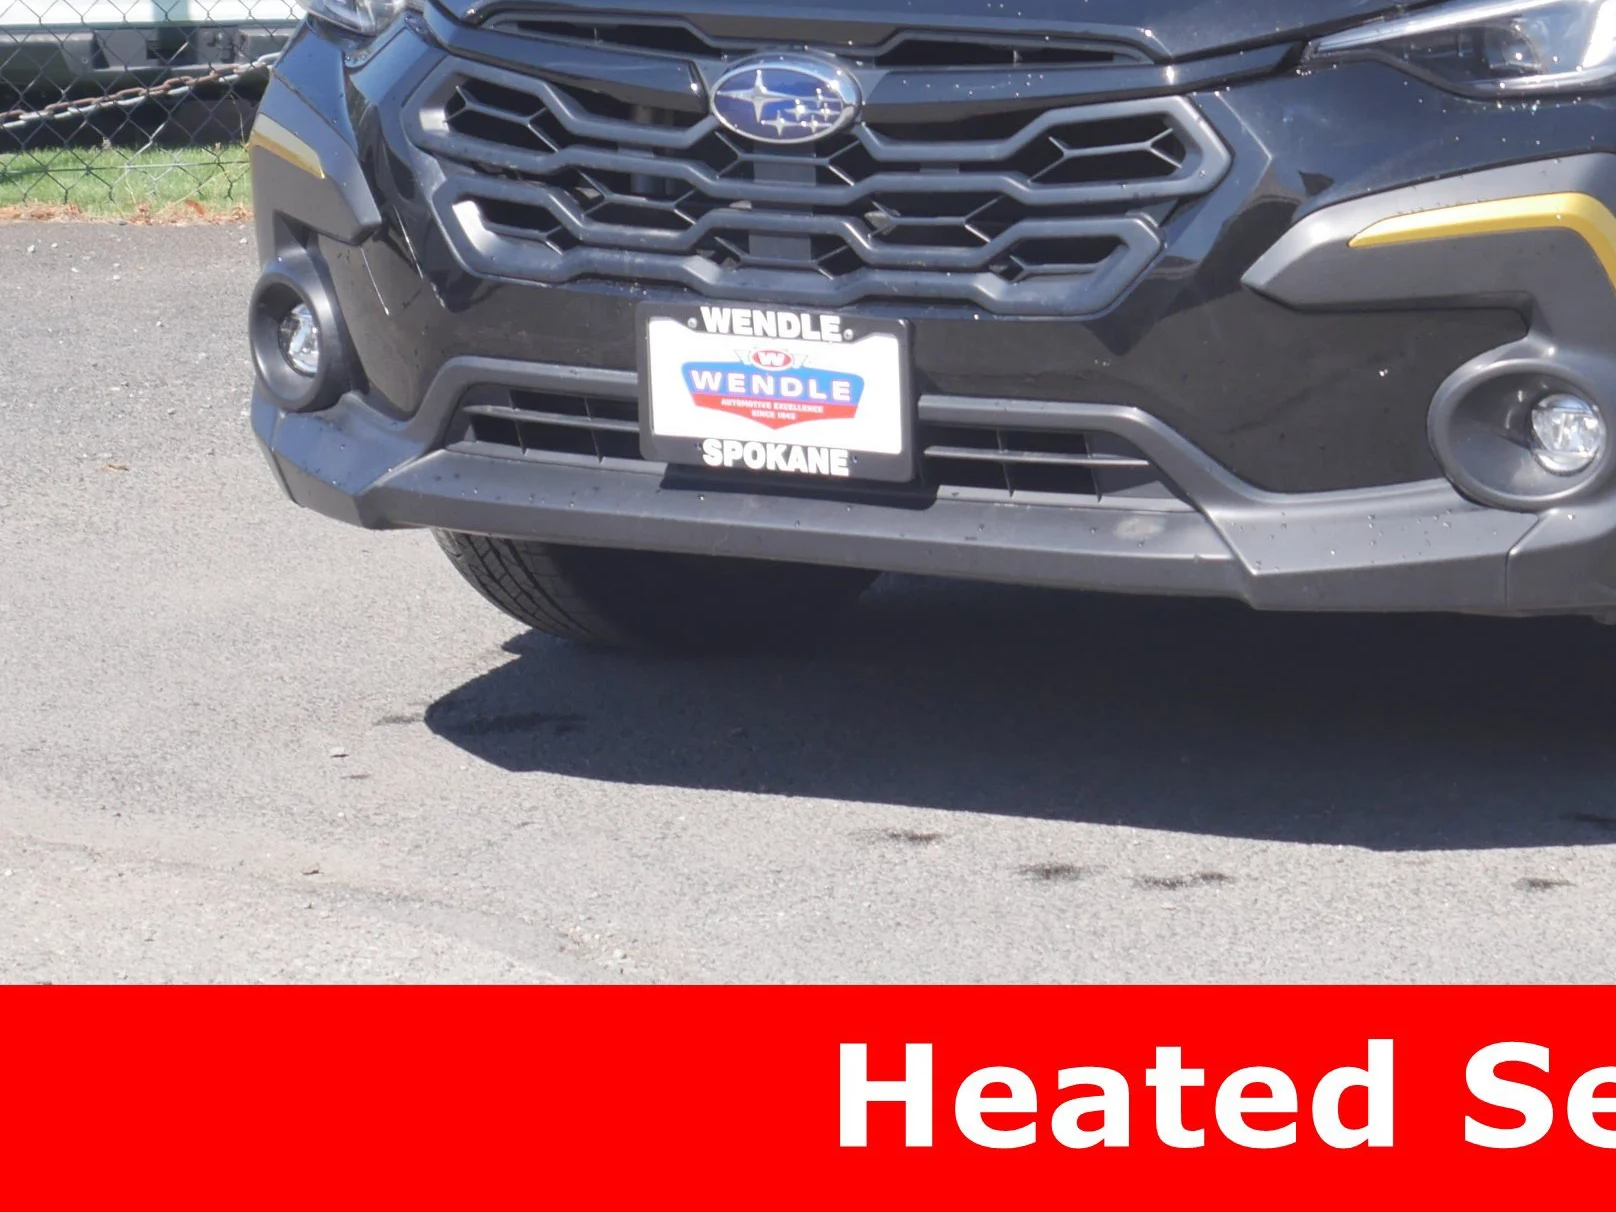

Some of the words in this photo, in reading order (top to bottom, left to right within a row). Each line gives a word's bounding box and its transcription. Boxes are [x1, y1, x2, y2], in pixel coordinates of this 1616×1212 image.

[700, 306, 842, 342] WENDLE
[691, 370, 851, 402] WENDLE
[721, 398, 772, 409] AUTOMOTIVE
[773, 401, 824, 414] EXCELLENCE
[751, 409, 775, 419] SINCE
[702, 438, 849, 476] SPOKANE
